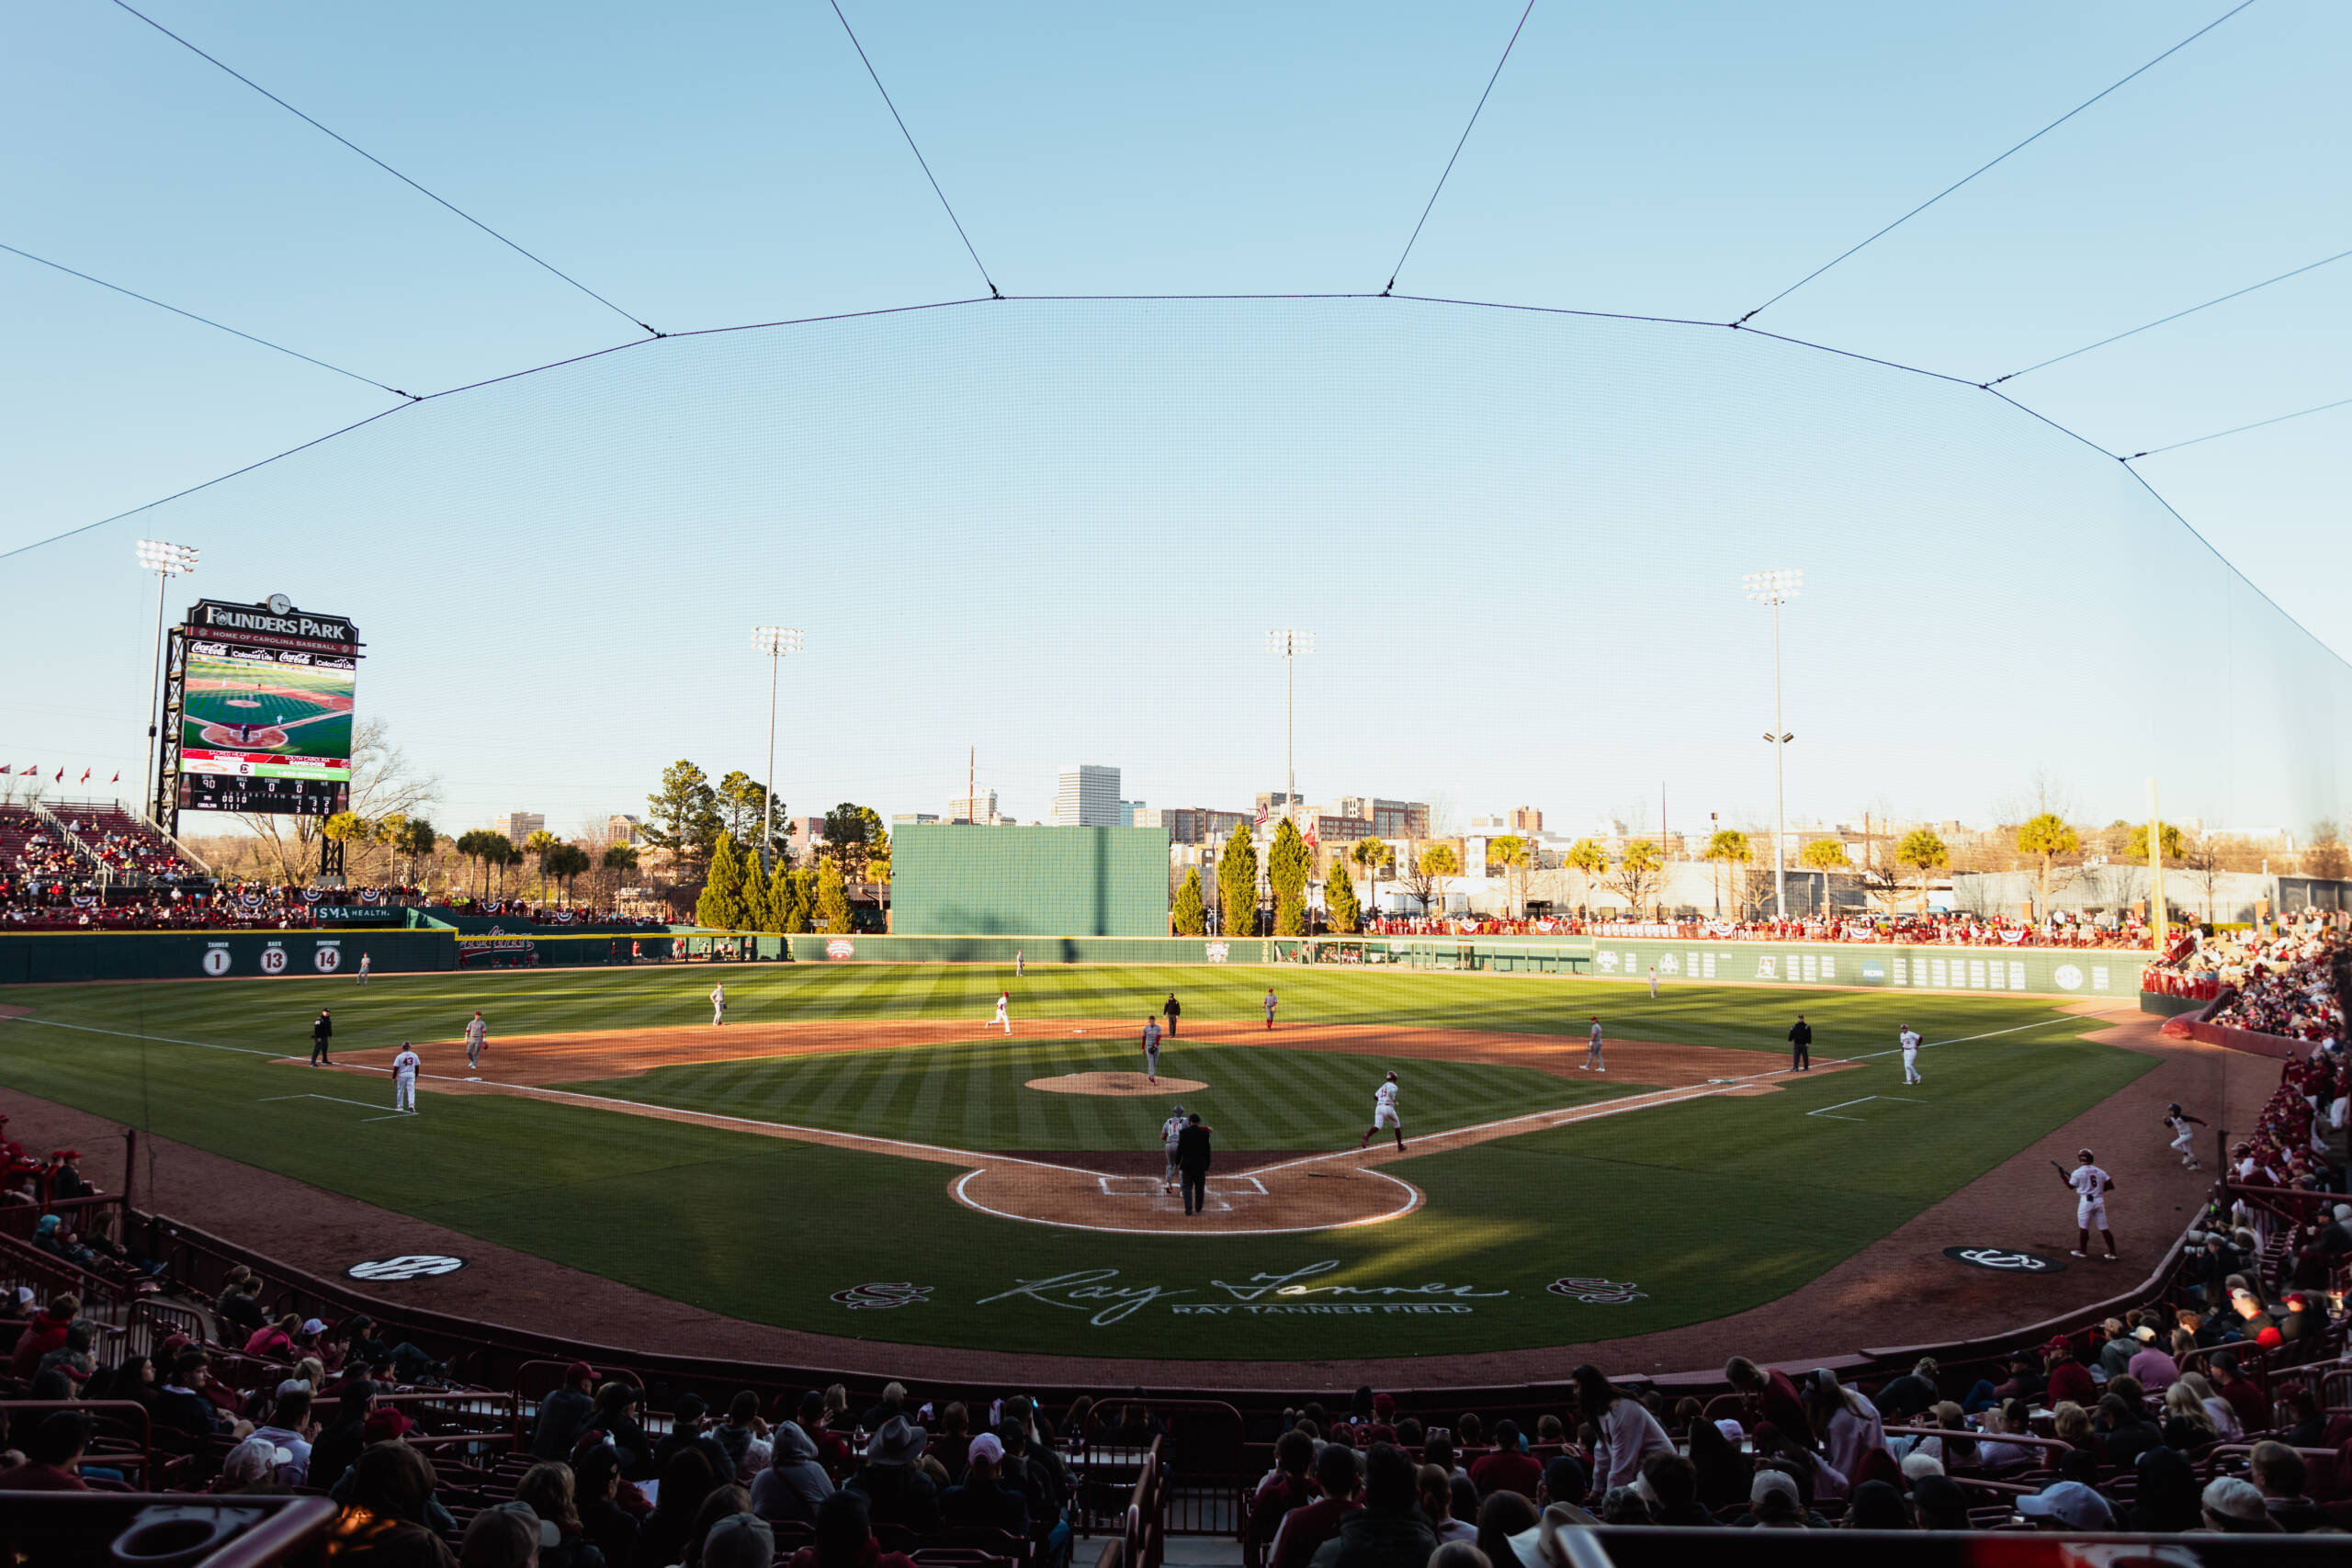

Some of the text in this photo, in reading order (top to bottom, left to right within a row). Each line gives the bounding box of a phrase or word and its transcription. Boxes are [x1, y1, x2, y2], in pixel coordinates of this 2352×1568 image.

[207, 606, 345, 639] FOUNDERS PARK
[213, 631, 238, 639] HOME
[253, 636, 294, 646] CAROLINA
[296, 640, 336, 650] BASEBALL
[232, 649, 261, 660] Colonial
[203, 779, 215, 789] 90
[239, 782, 245, 790] 4
[268, 783, 275, 792] 0
[296, 784, 302, 794] 0
[214, 953, 220, 969] 1
[266, 953, 283, 968] 13
[320, 952, 335, 966] 14
[2090, 1175, 2098, 1188] 6
[1172, 1304, 1474, 1314] RAY TANNER FIELD
